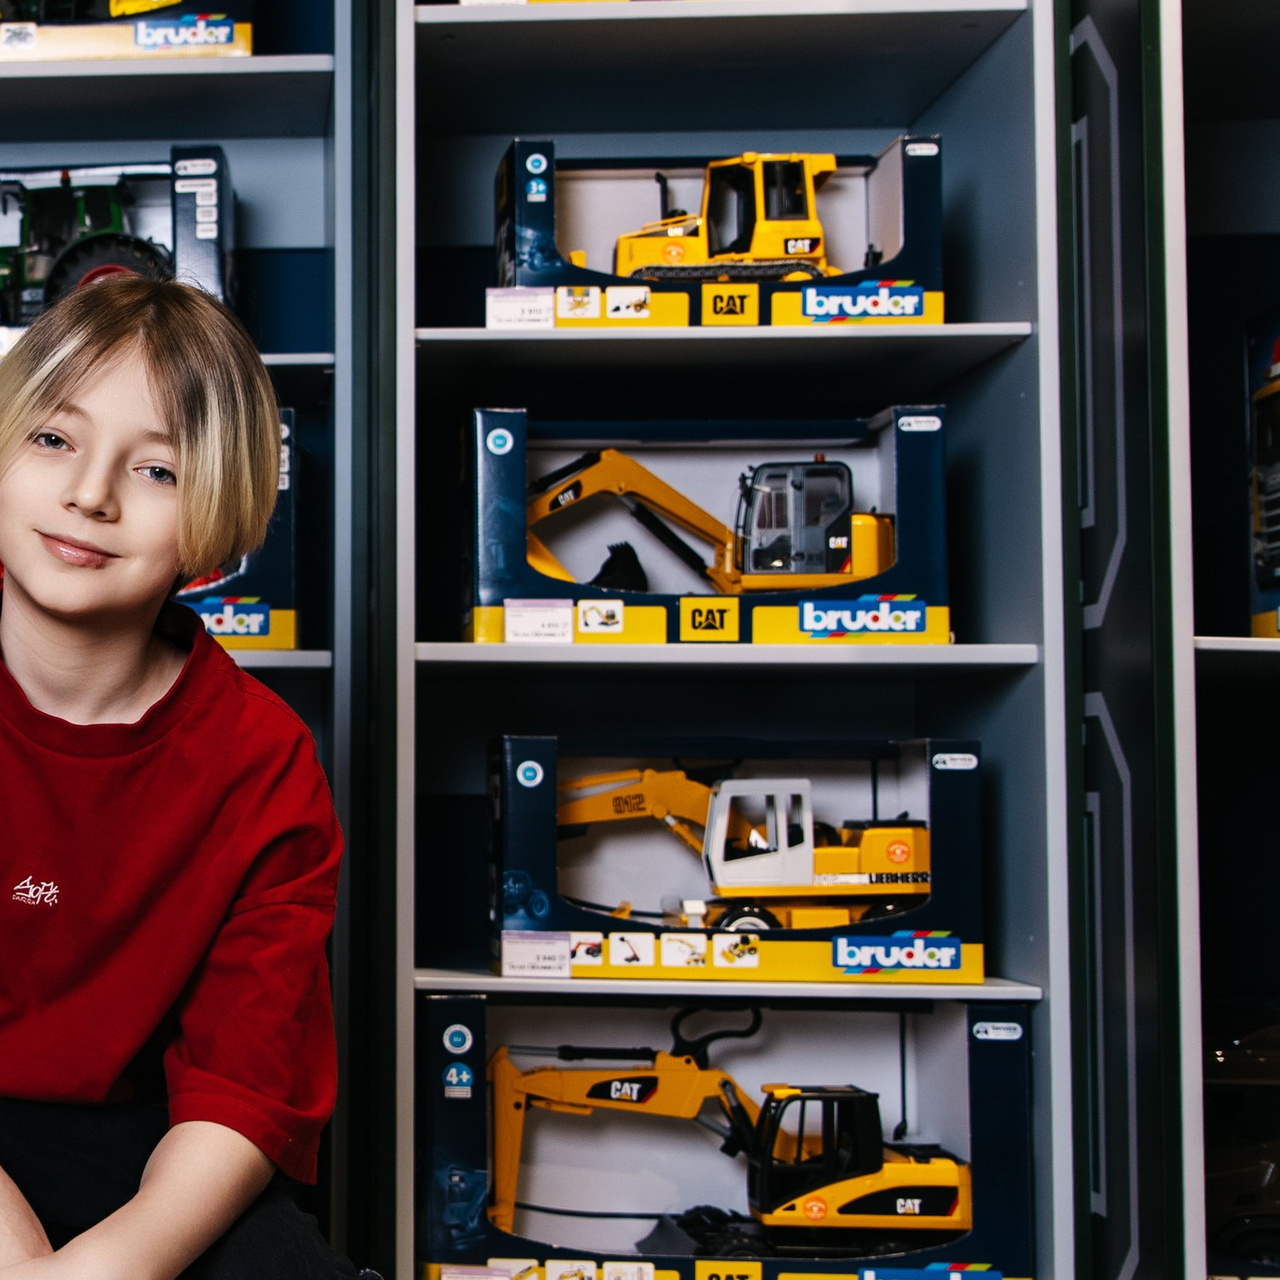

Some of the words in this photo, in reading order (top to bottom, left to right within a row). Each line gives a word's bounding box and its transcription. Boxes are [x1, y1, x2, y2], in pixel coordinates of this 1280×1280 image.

[136, 19, 231, 45] bruder
[787, 238, 812, 254] CAT
[712, 295, 747, 315] CAT
[806, 288, 919, 316] bruder
[829, 535, 848, 549] CAT
[201, 605, 264, 634] der
[691, 607, 729, 630] CAT
[802, 603, 920, 631] bruder
[612, 793, 647, 814] 912
[869, 872, 930, 884] LIEBHERR
[836, 937, 957, 968] bruder
[446, 1067, 471, 1085] 4+
[610, 1080, 641, 1101] CAT
[896, 1198, 921, 1215] CAT
